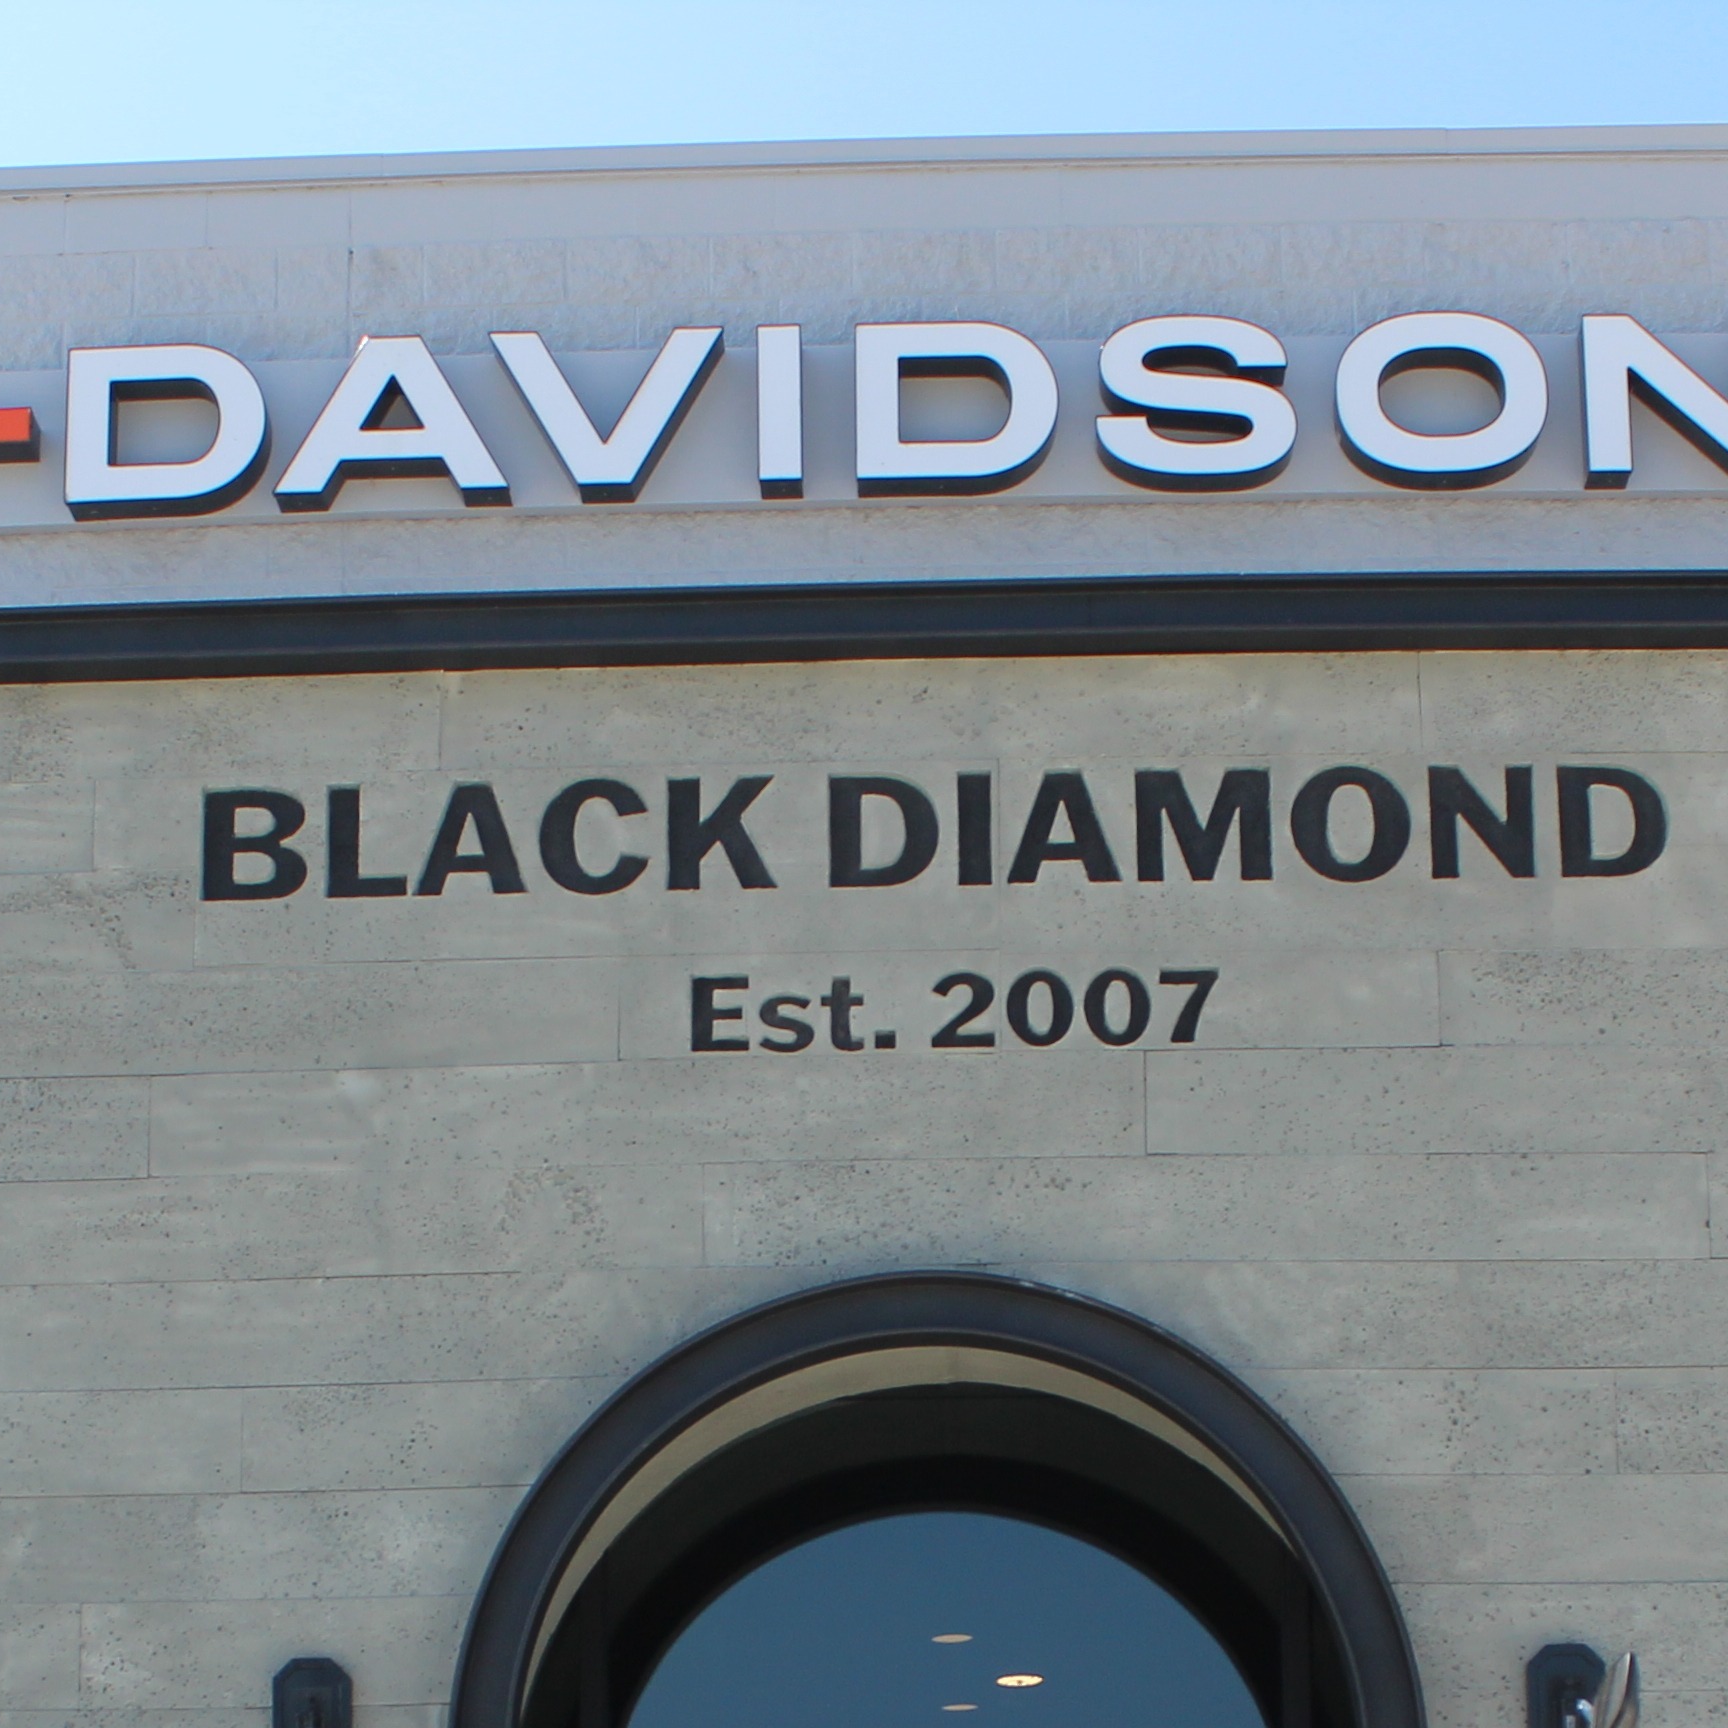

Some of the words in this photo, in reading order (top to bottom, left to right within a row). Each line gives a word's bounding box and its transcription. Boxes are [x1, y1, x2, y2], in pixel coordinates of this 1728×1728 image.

[200, 775, 778, 903] BLACK
[828, 762, 1669, 892] DIAMOND
[688, 975, 898, 1054] Est.
[931, 967, 1221, 1049] 2007
